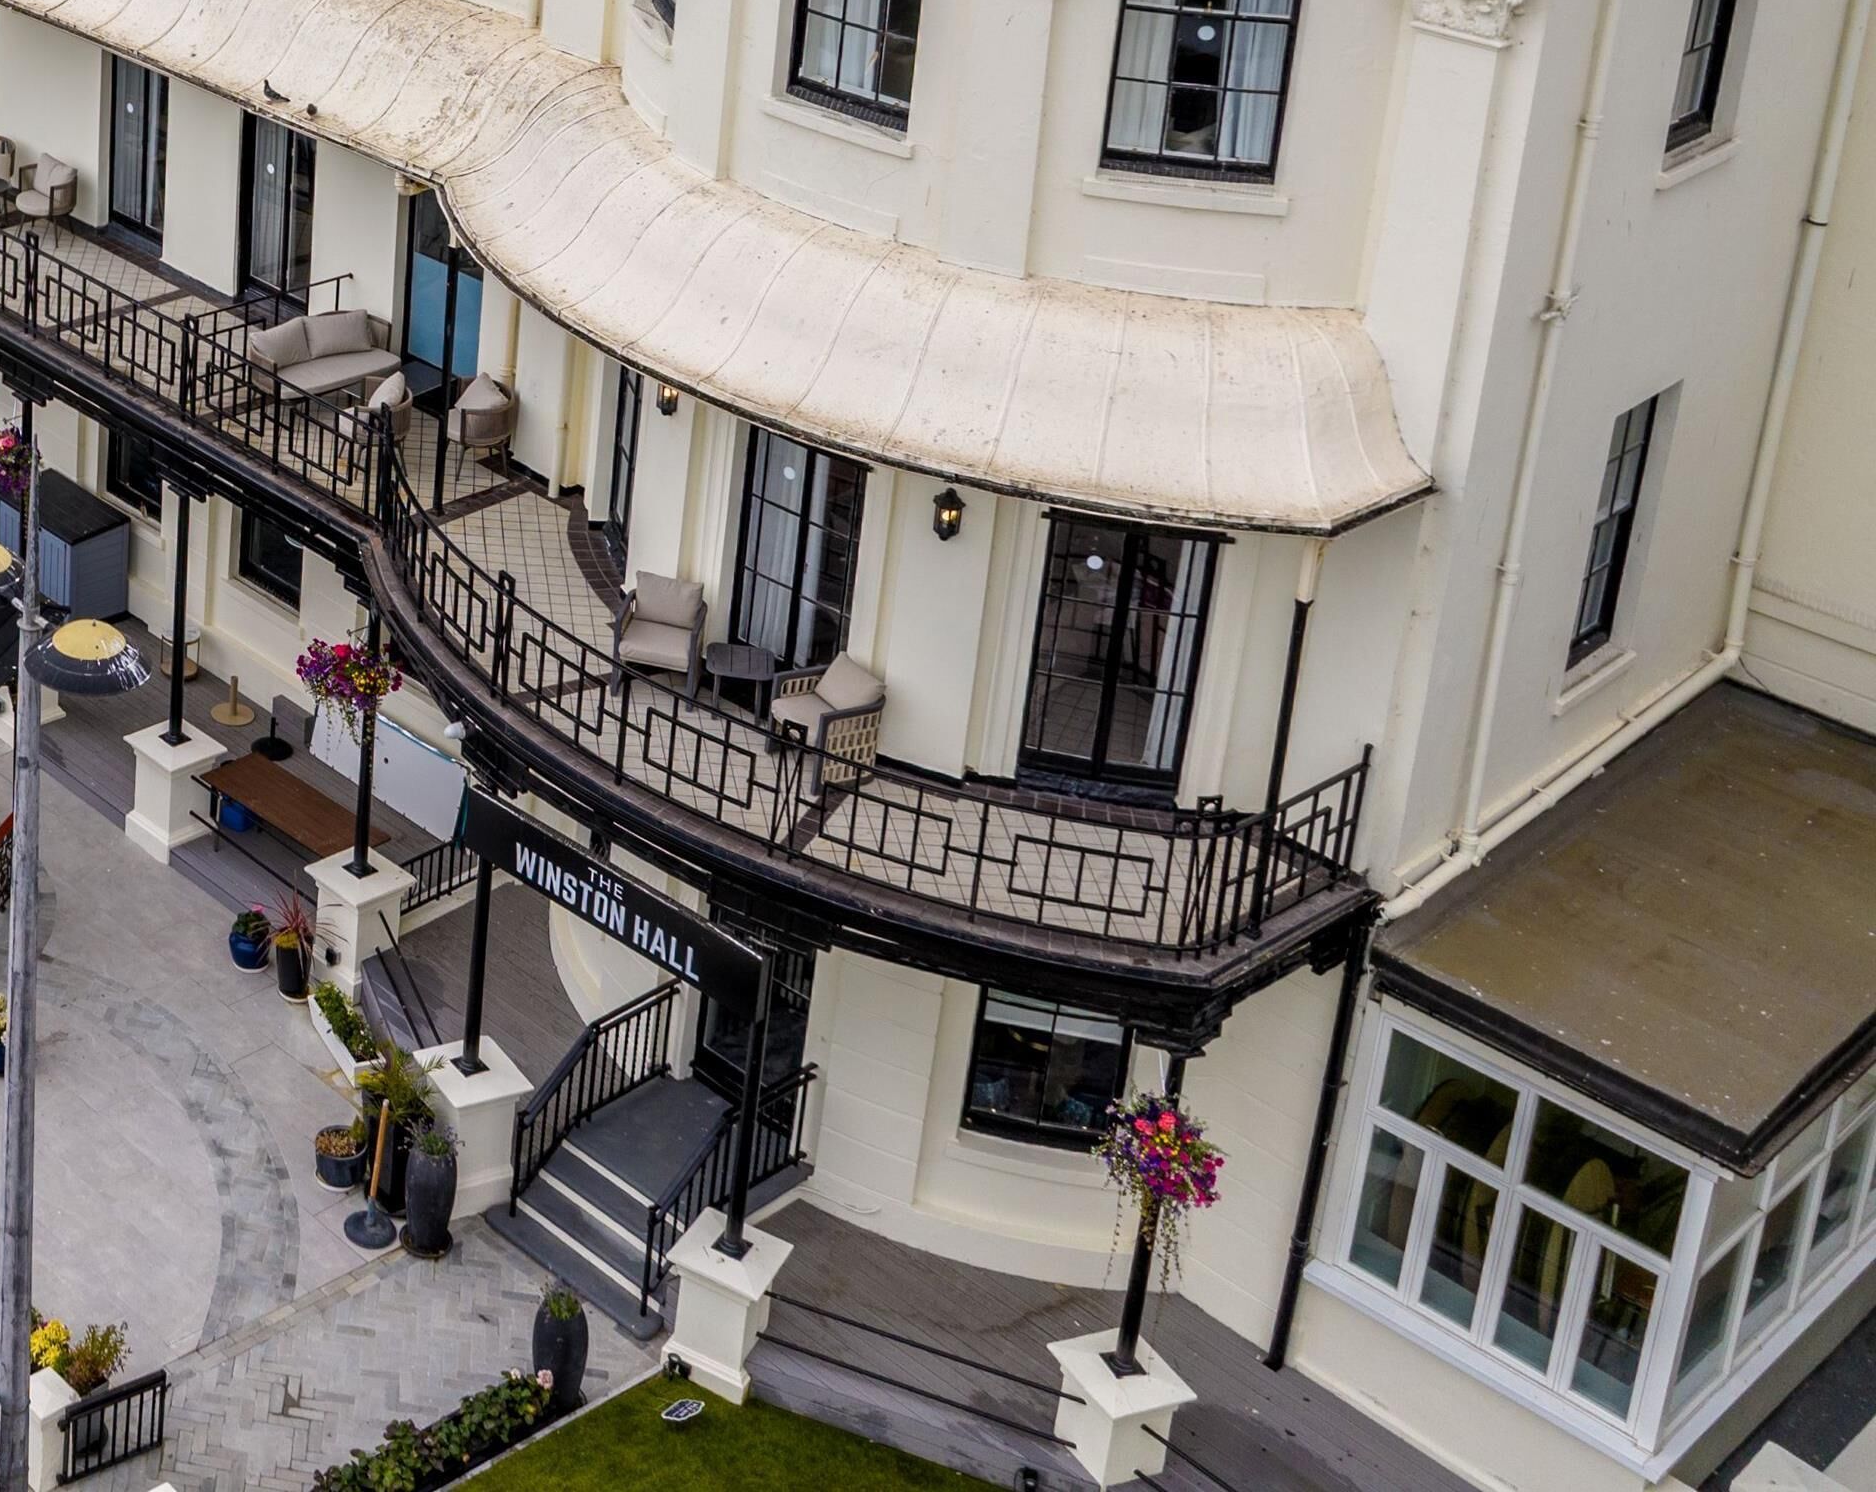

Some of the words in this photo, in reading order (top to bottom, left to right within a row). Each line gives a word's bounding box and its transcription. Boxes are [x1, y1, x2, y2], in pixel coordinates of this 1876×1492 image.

[515, 841, 626, 936] WINSTON
[632, 913, 700, 983] HALL
[587, 866, 624, 901] THE
